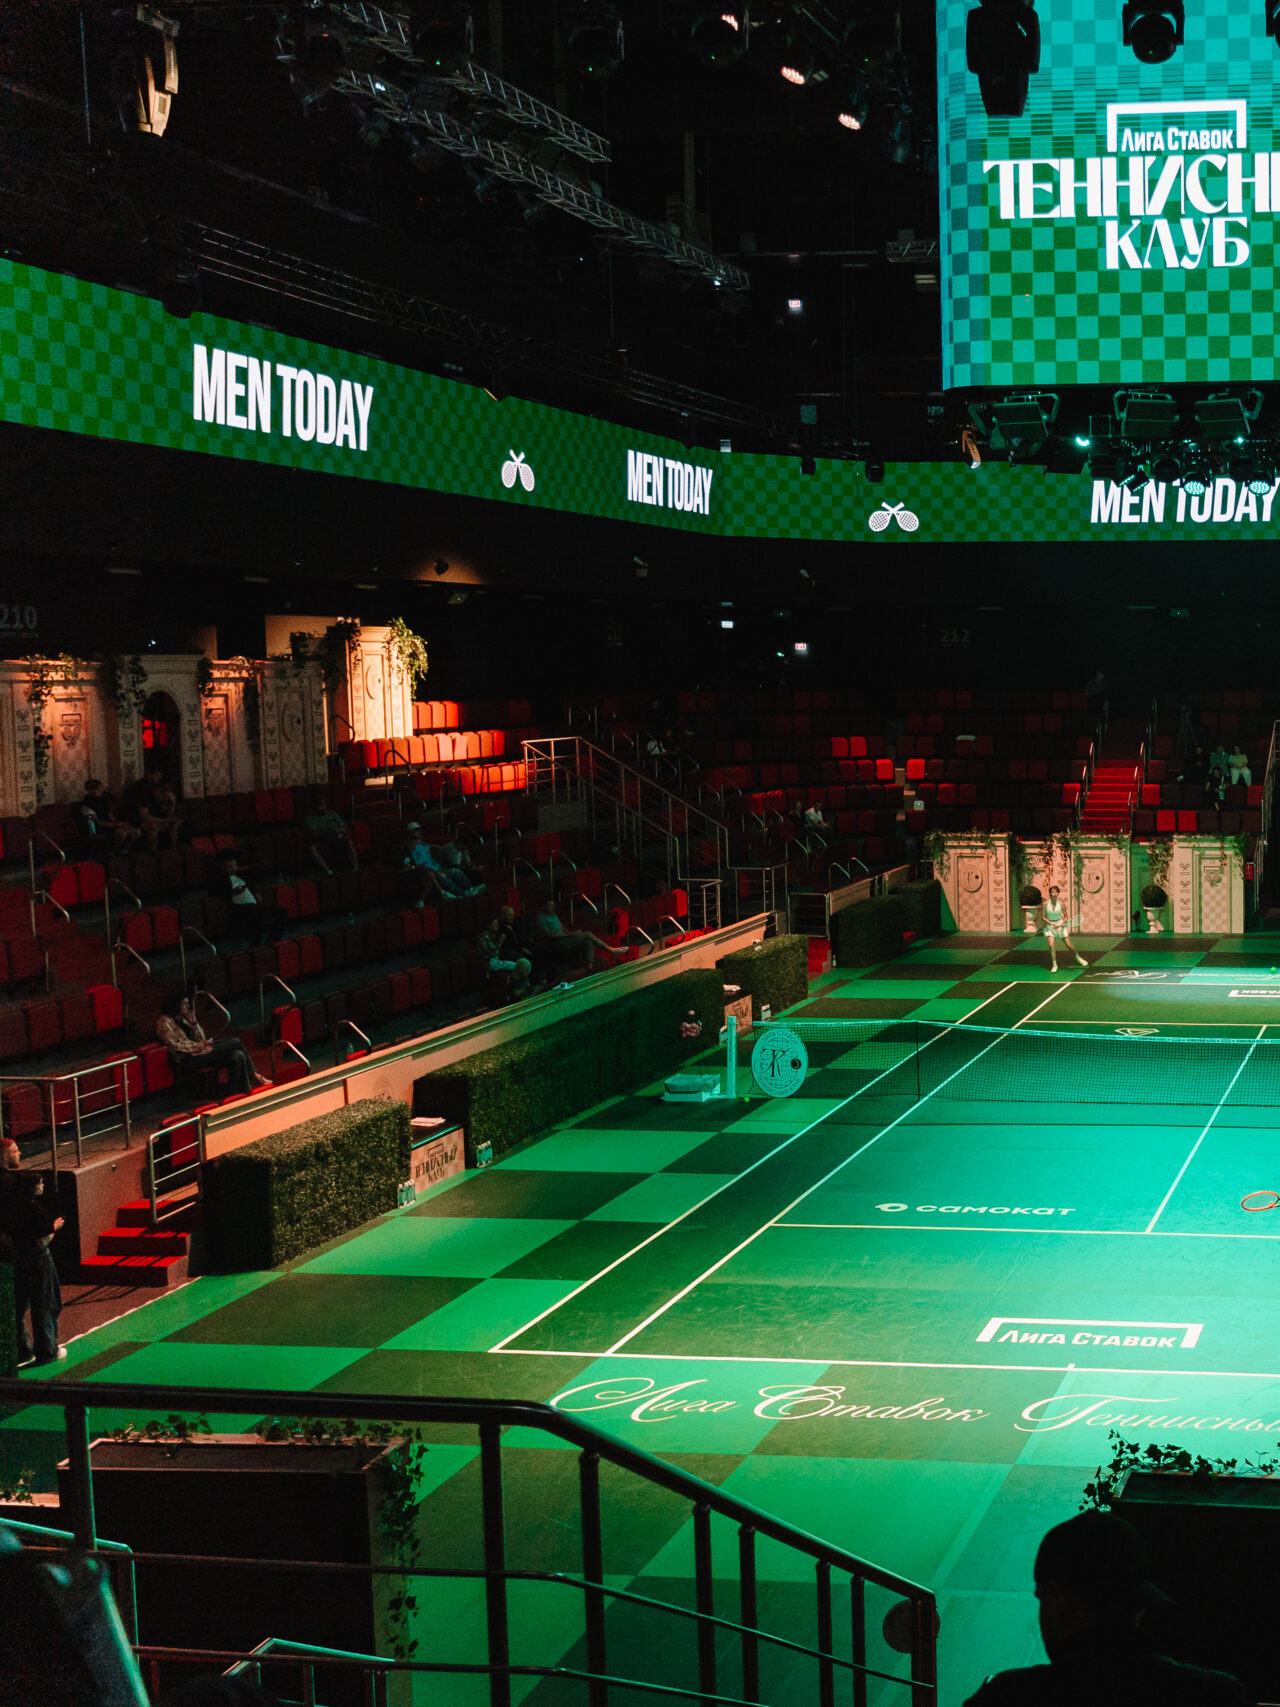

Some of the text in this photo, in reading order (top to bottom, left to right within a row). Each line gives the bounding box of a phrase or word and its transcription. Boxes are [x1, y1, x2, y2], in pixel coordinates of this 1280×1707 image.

[1106, 217, 1249, 269] КЛУБ
[193, 344, 373, 451] MEN TODAY
[627, 450, 713, 515] MEN TODAY
[1091, 479, 1166, 523] MEN
